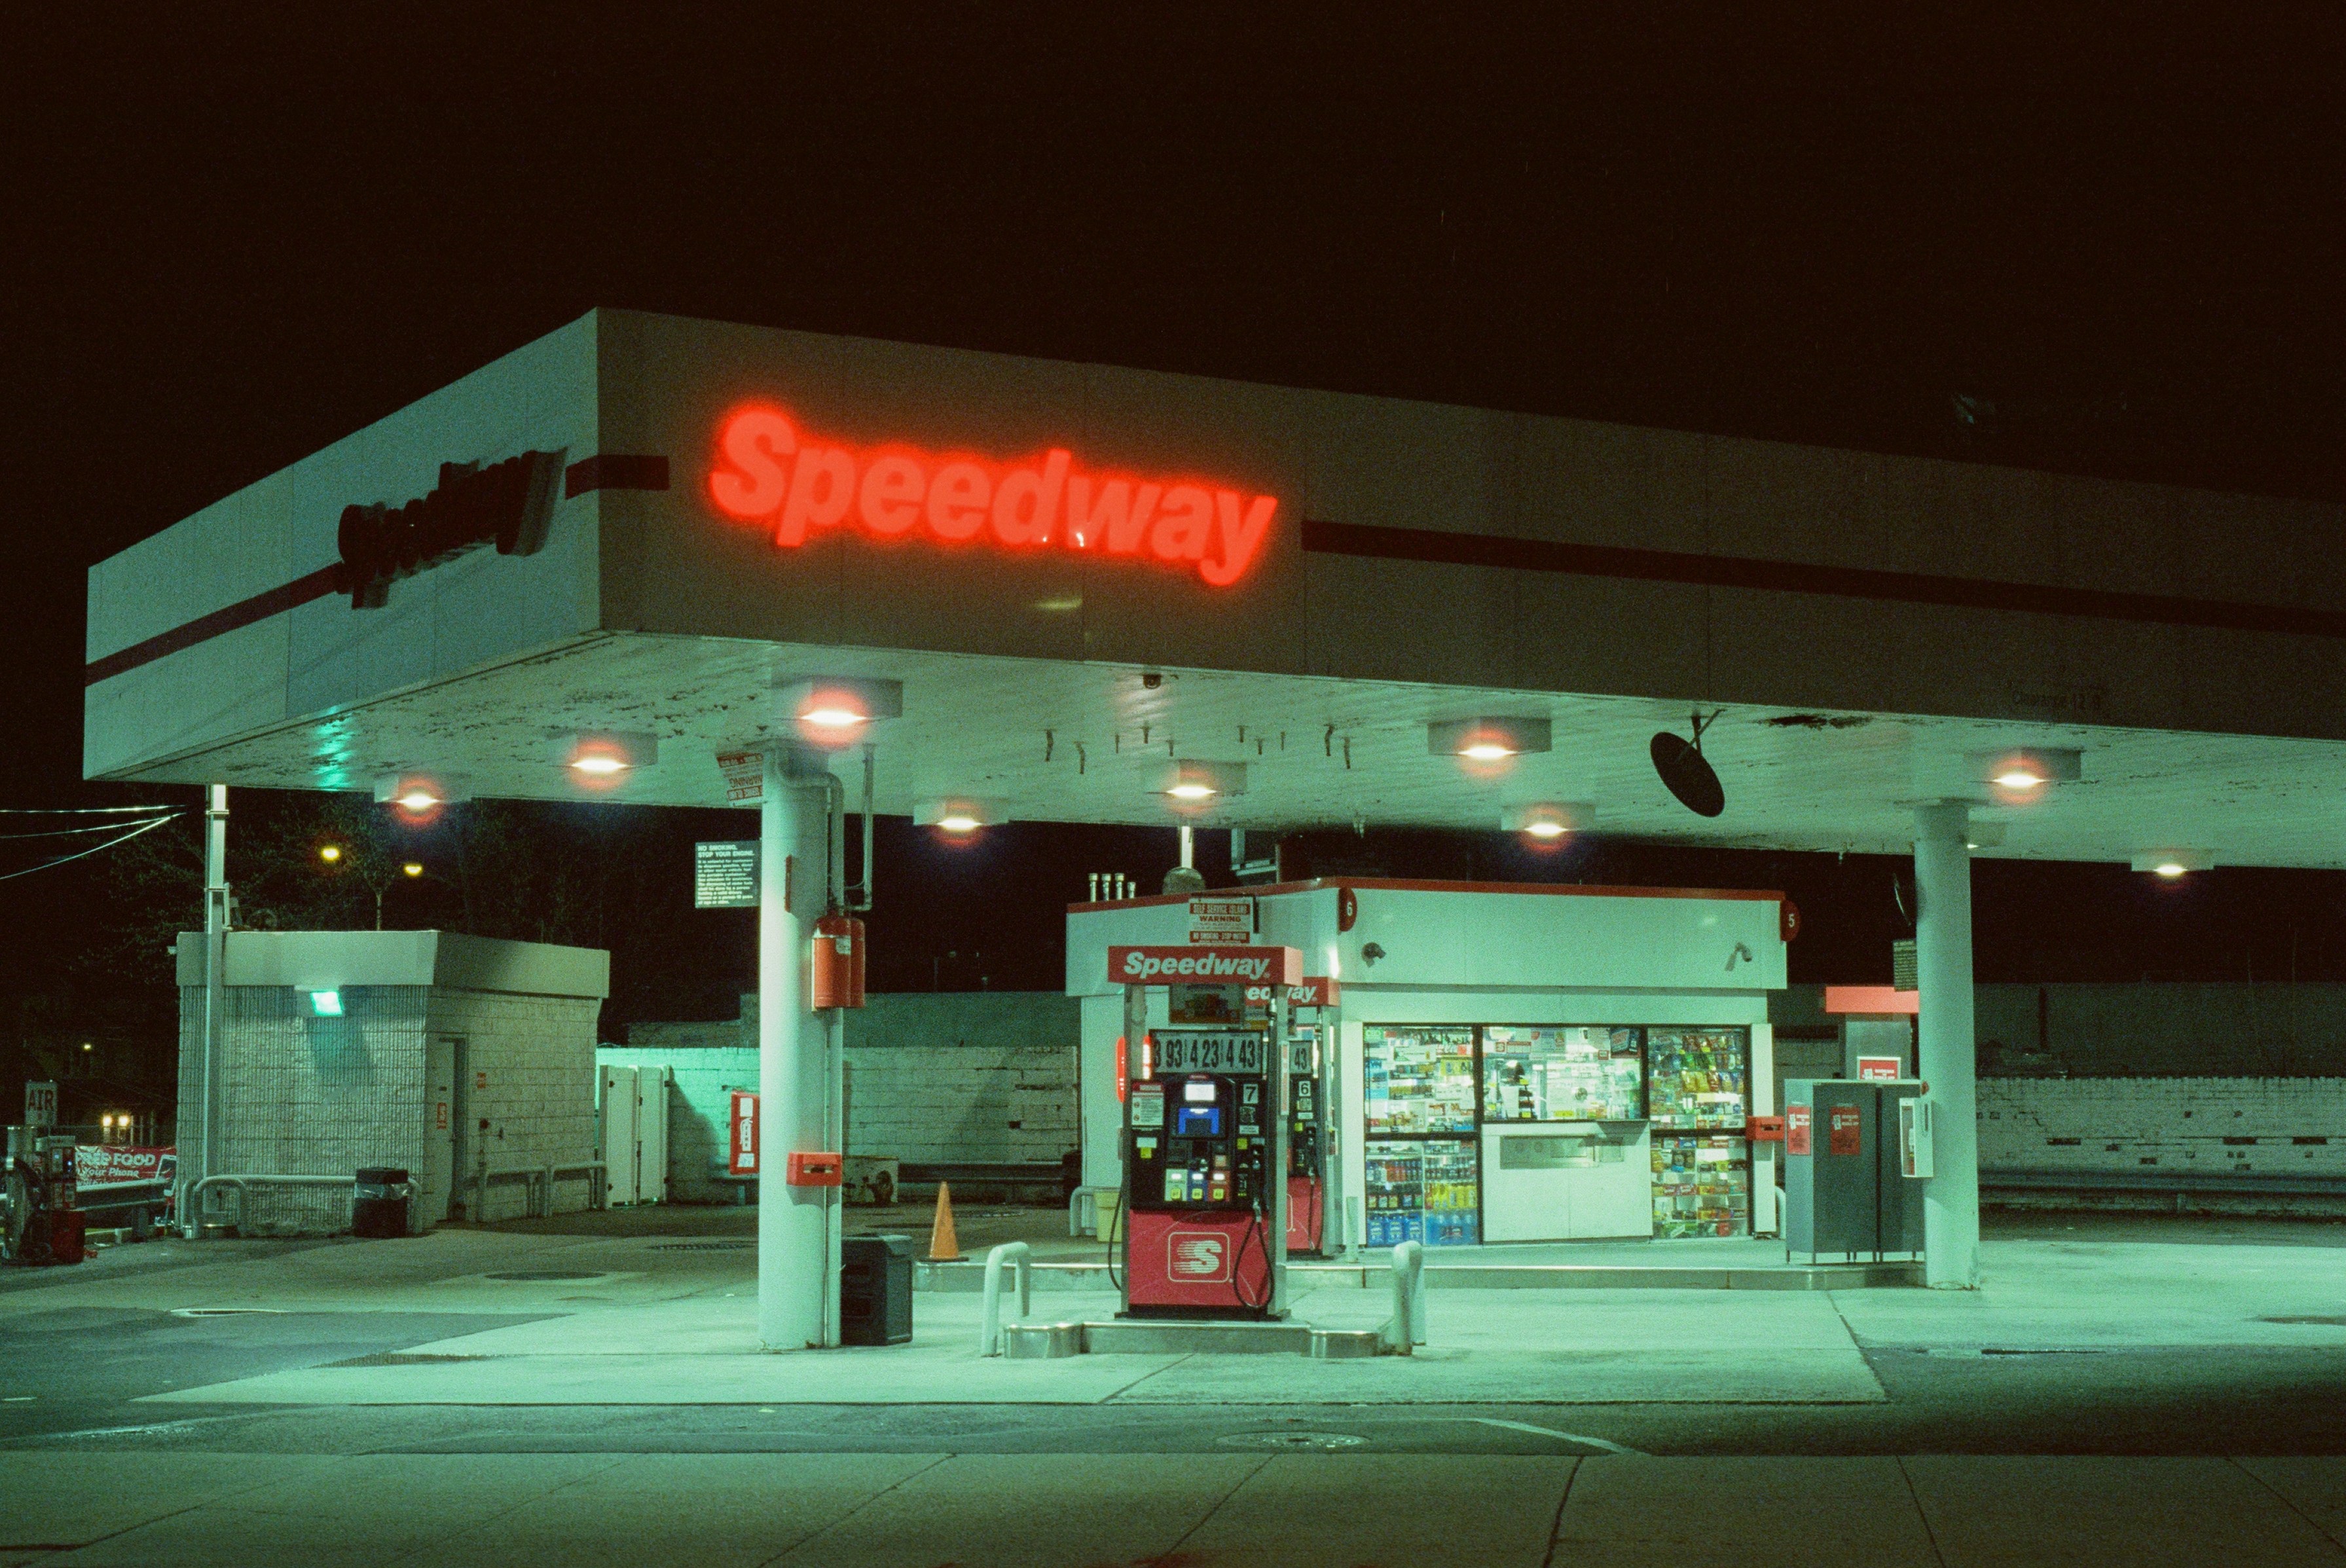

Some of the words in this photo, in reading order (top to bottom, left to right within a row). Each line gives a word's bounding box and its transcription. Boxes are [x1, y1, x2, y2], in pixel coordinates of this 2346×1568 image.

[710, 411, 1278, 585] Speedway
[1347, 902, 1353, 917] 6
[1788, 913, 1795, 928] 5
[1124, 952, 1270, 980] Speedway
[1245, 1086, 1257, 1102] 7
[1300, 1083, 1309, 1095] 6
[28, 1089, 54, 1111] AIR
[75, 1152, 110, 1165] FREE
[113, 1153, 155, 1166] FOOD
[84, 1167, 107, 1176] Your
[109, 1167, 139, 1178] Phone
